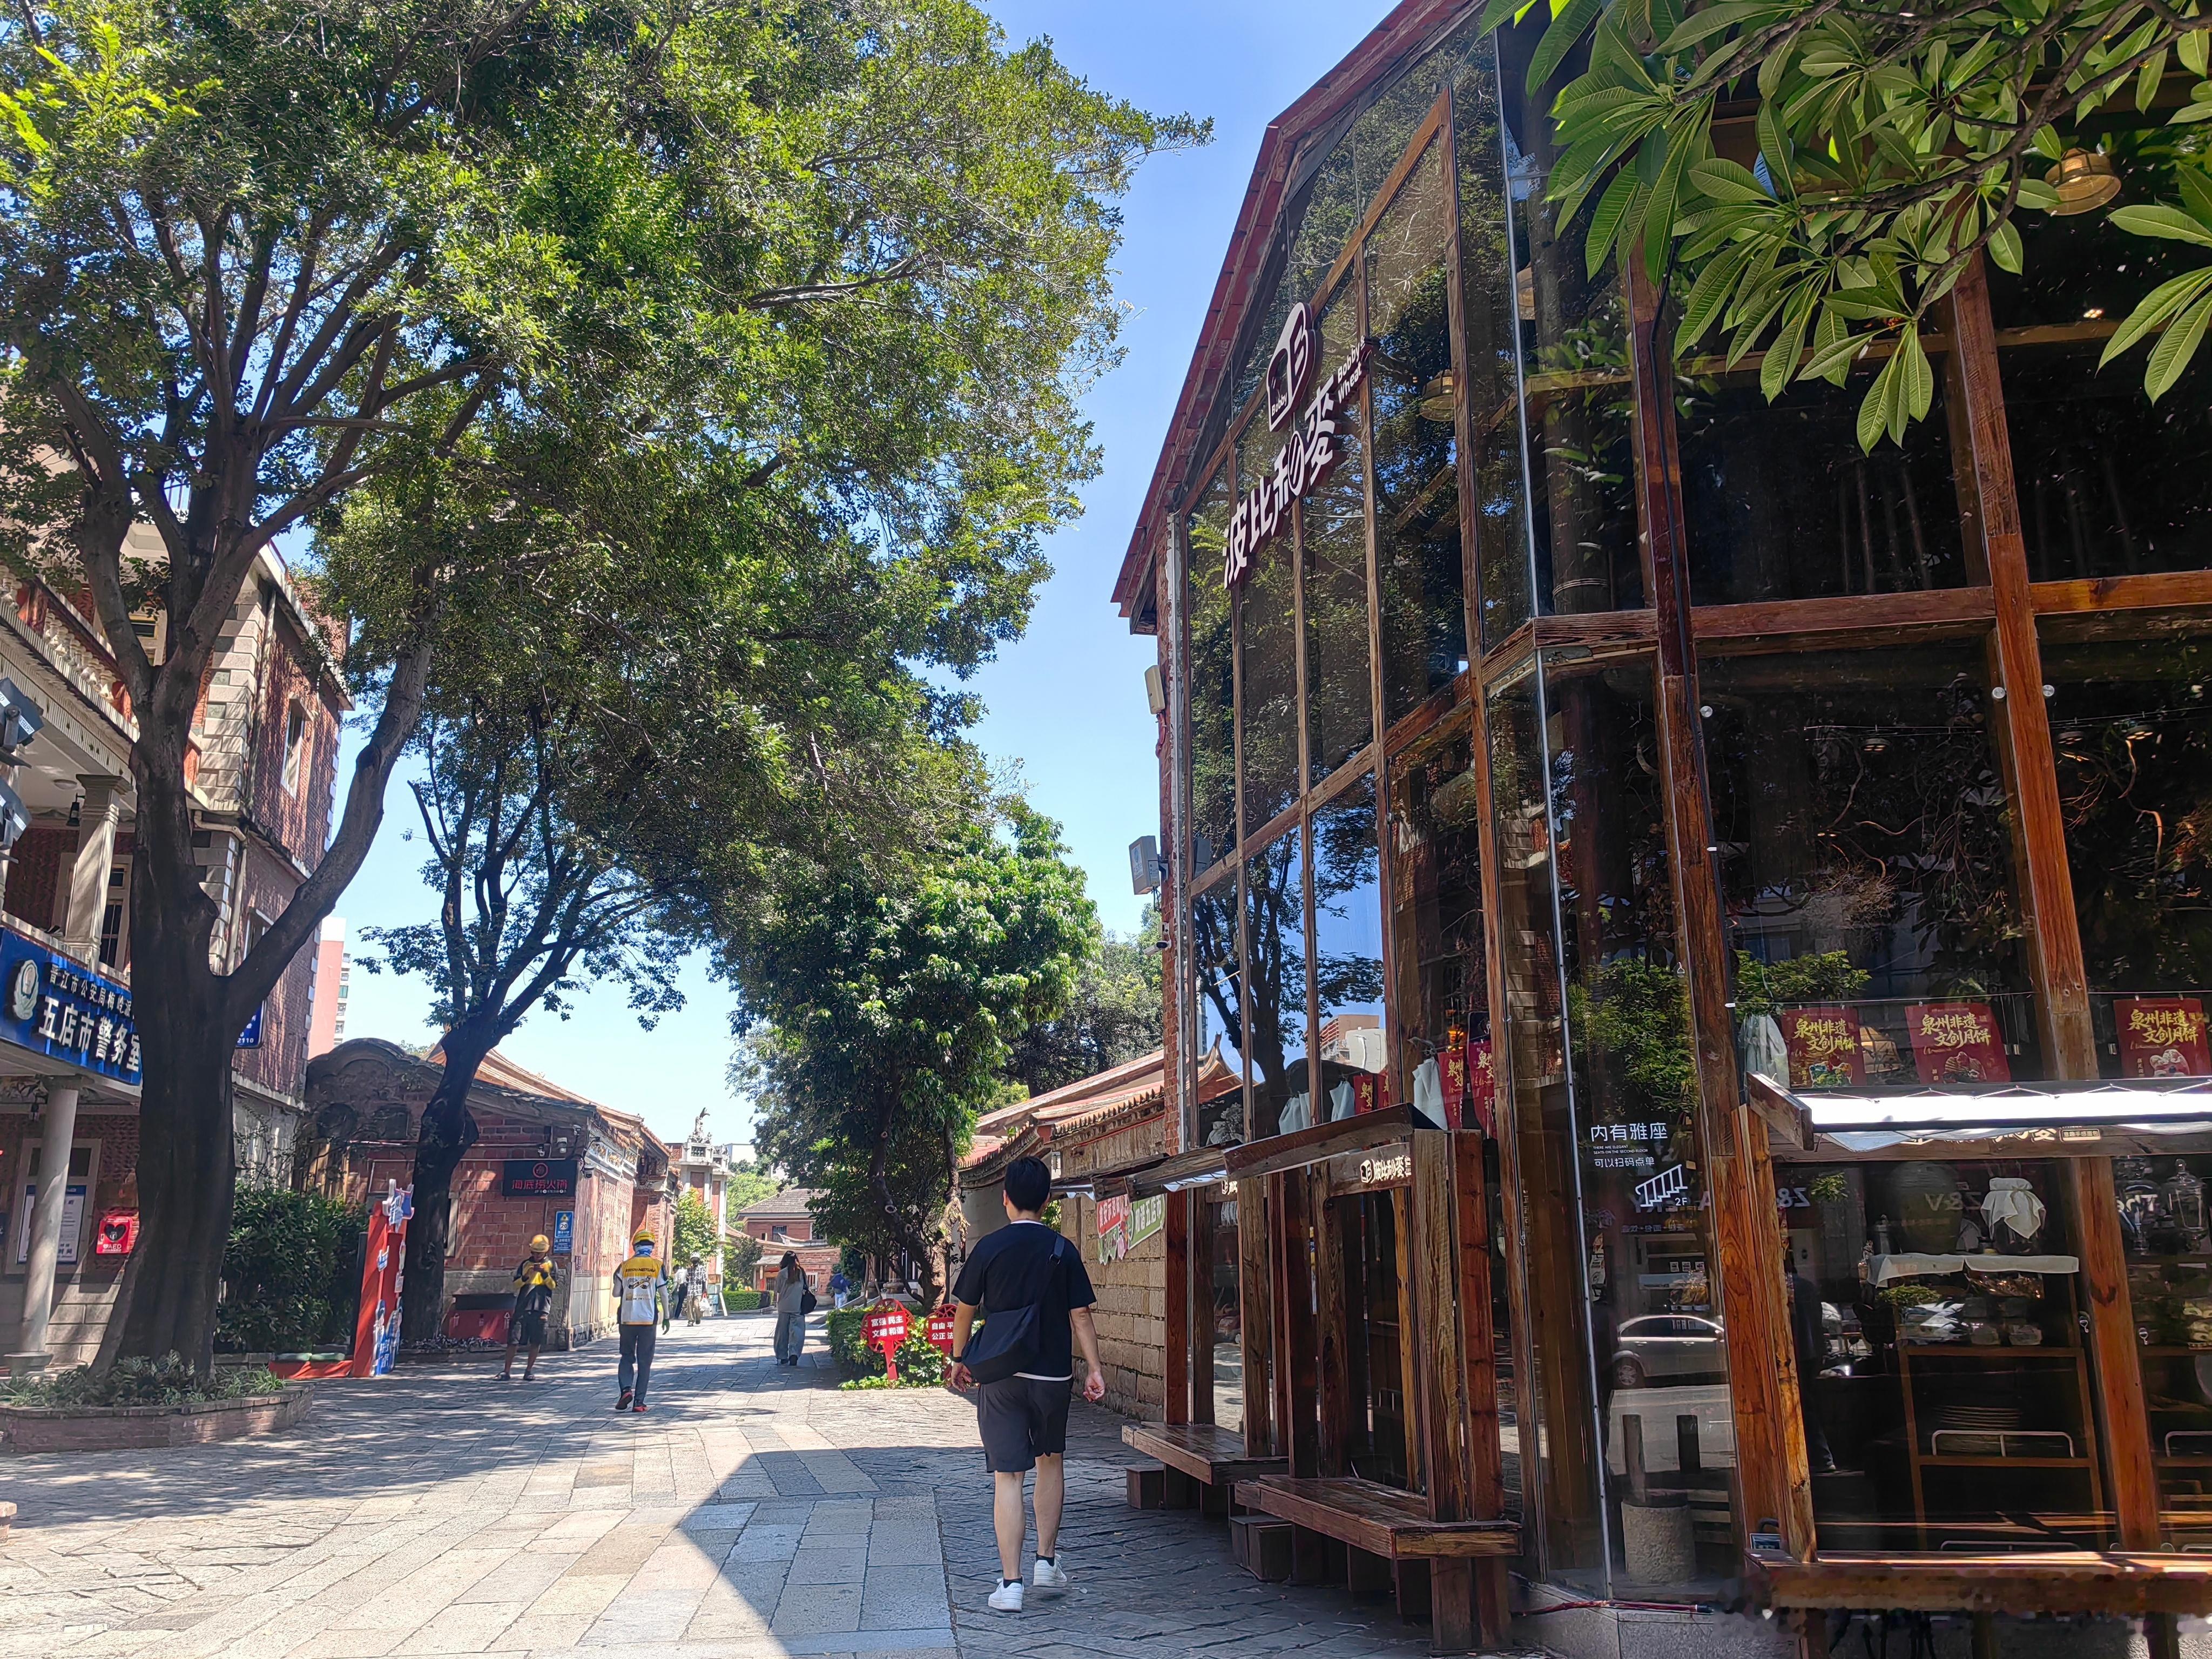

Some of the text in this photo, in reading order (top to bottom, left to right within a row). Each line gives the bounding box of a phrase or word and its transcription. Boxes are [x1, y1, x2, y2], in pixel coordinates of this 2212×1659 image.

[1338, 342, 1360, 384] Bobby
[1338, 361, 1362, 404] Wheat
[1271, 393, 1287, 417] Bobby
[50, 963, 134, 1020] 晋江市公安局梅岭派
[1792, 1018, 1849, 1038] 泉州非遗
[1919, 1012, 1981, 1036] 泉州非遗
[2127, 1009, 2189, 1031] 泉州非遗
[38, 995, 140, 1073] 五店市警务室
[1806, 1035, 1858, 1054] 文创月饼
[1934, 1028, 1992, 1049] 文创月饼
[2142, 1027, 2198, 1048] 文创月饼
[1590, 1122, 1668, 1142] 内有雅座
[1594, 1157, 1655, 1168] 可以扫码点单
[1675, 1197, 1688, 1206] 2F
[871, 1316, 903, 1327] 富强 民主
[872, 1326, 904, 1338] 文明 和谐
[947, 1321, 954, 1330] 平
